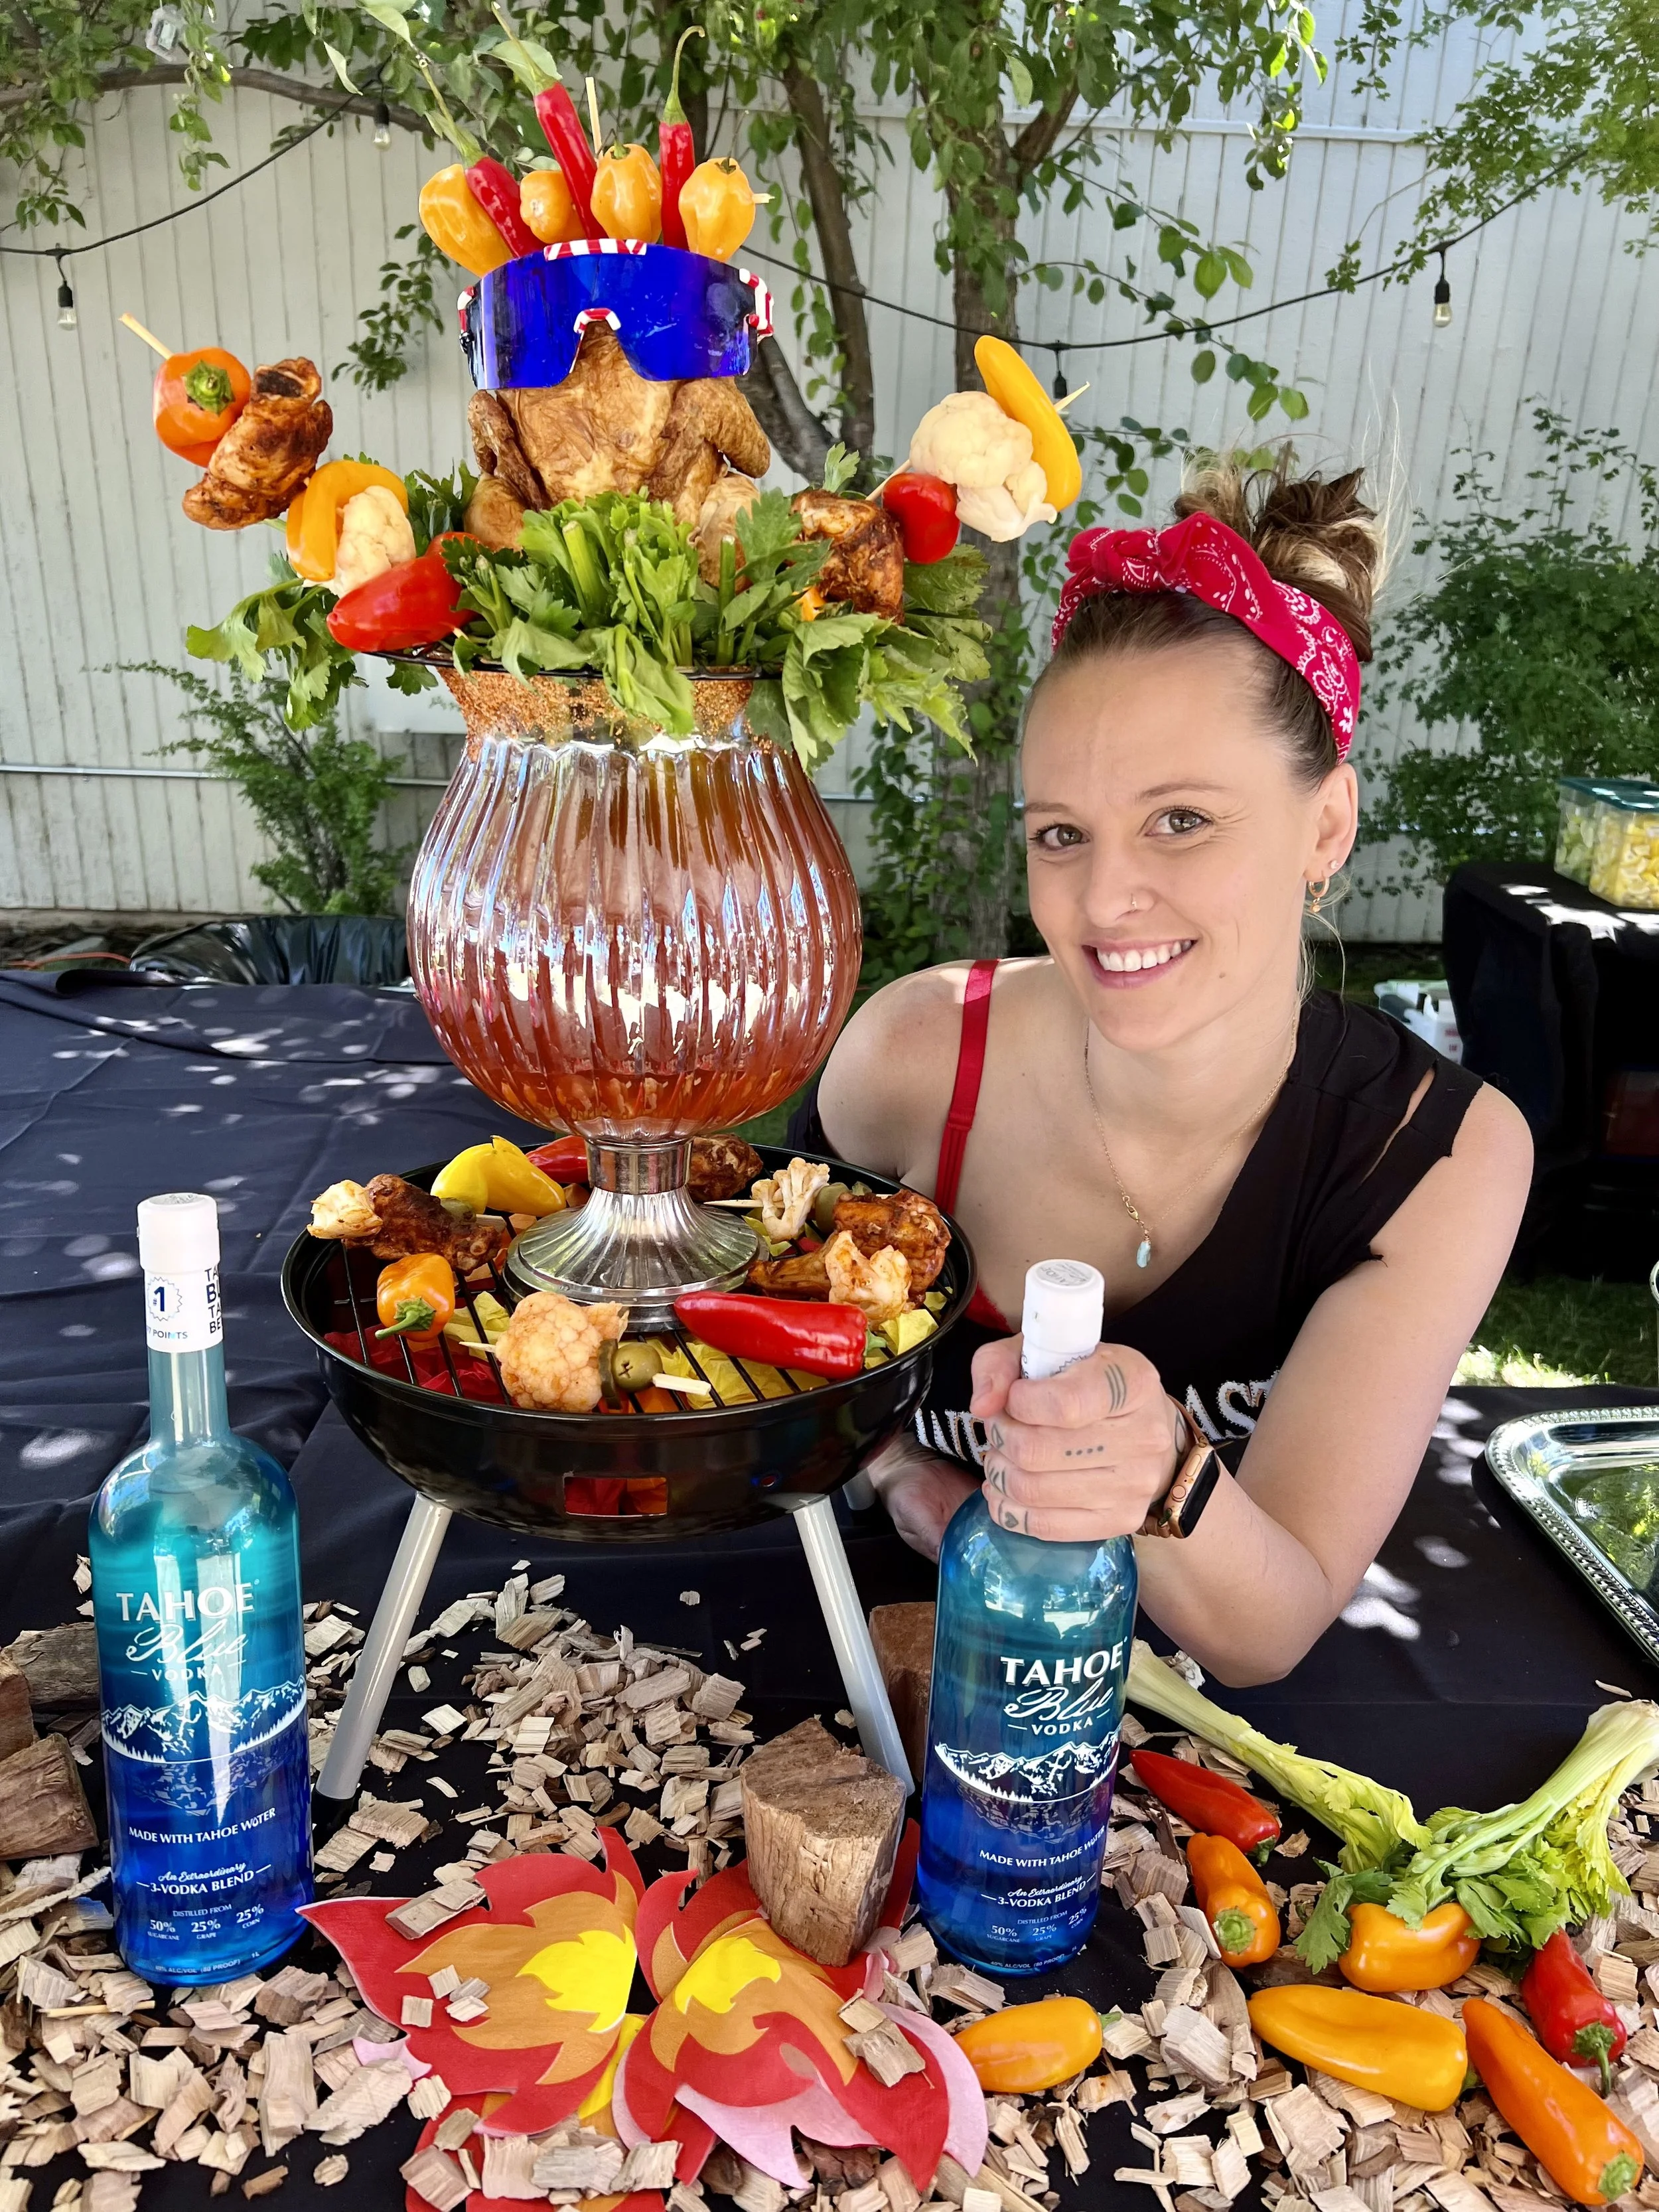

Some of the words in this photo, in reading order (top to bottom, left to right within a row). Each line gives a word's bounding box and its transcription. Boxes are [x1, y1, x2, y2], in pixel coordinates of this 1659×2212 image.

[153, 1329, 188, 1339] POINTS
[116, 1582, 255, 1623] TAHOE
[126, 1619, 250, 1664] Blue
[152, 1664, 222, 1682] VODKA
[1000, 1640, 1123, 1686] TAHOE
[1003, 1676, 1114, 1721] Blue
[1031, 1716, 1093, 1735] VODKA
[129, 1826, 158, 1842] MADE
[160, 1833, 193, 1843] WITH
[195, 1824, 238, 1842] TAHOE
[979, 1850, 1013, 1866] MADE
[1015, 1858, 1046, 1867] WITH
[1049, 1846, 1082, 1865] TAHOE
[150, 1882, 208, 1895] 3-VODKA
[211, 1870, 254, 1891] BLEND
[158, 1872, 178, 1881] An
[178, 1862, 246, 1882] Extraordinary
[997, 1897, 1052, 1907] 3-VODKA
[1054, 1880, 1086, 1903] BLEND
[1007, 1888, 1027, 1897] An
[1027, 1876, 1082, 1897] Extraordinary
[149, 1919, 176, 1933] 50%
[190, 1919, 221, 1933] 25%
[236, 1903, 264, 1923] 25%
[210, 1903, 232, 1914] FROM
[1017, 1916, 1049, 1925] DISTILLED
[1050, 1910, 1068, 1921] FROM
[242, 1918, 260, 1929] CORN
[991, 1925, 1017, 1937] 50%
[1032, 1924, 1056, 1936] 25%
[1068, 1905, 1087, 1925] 25%
